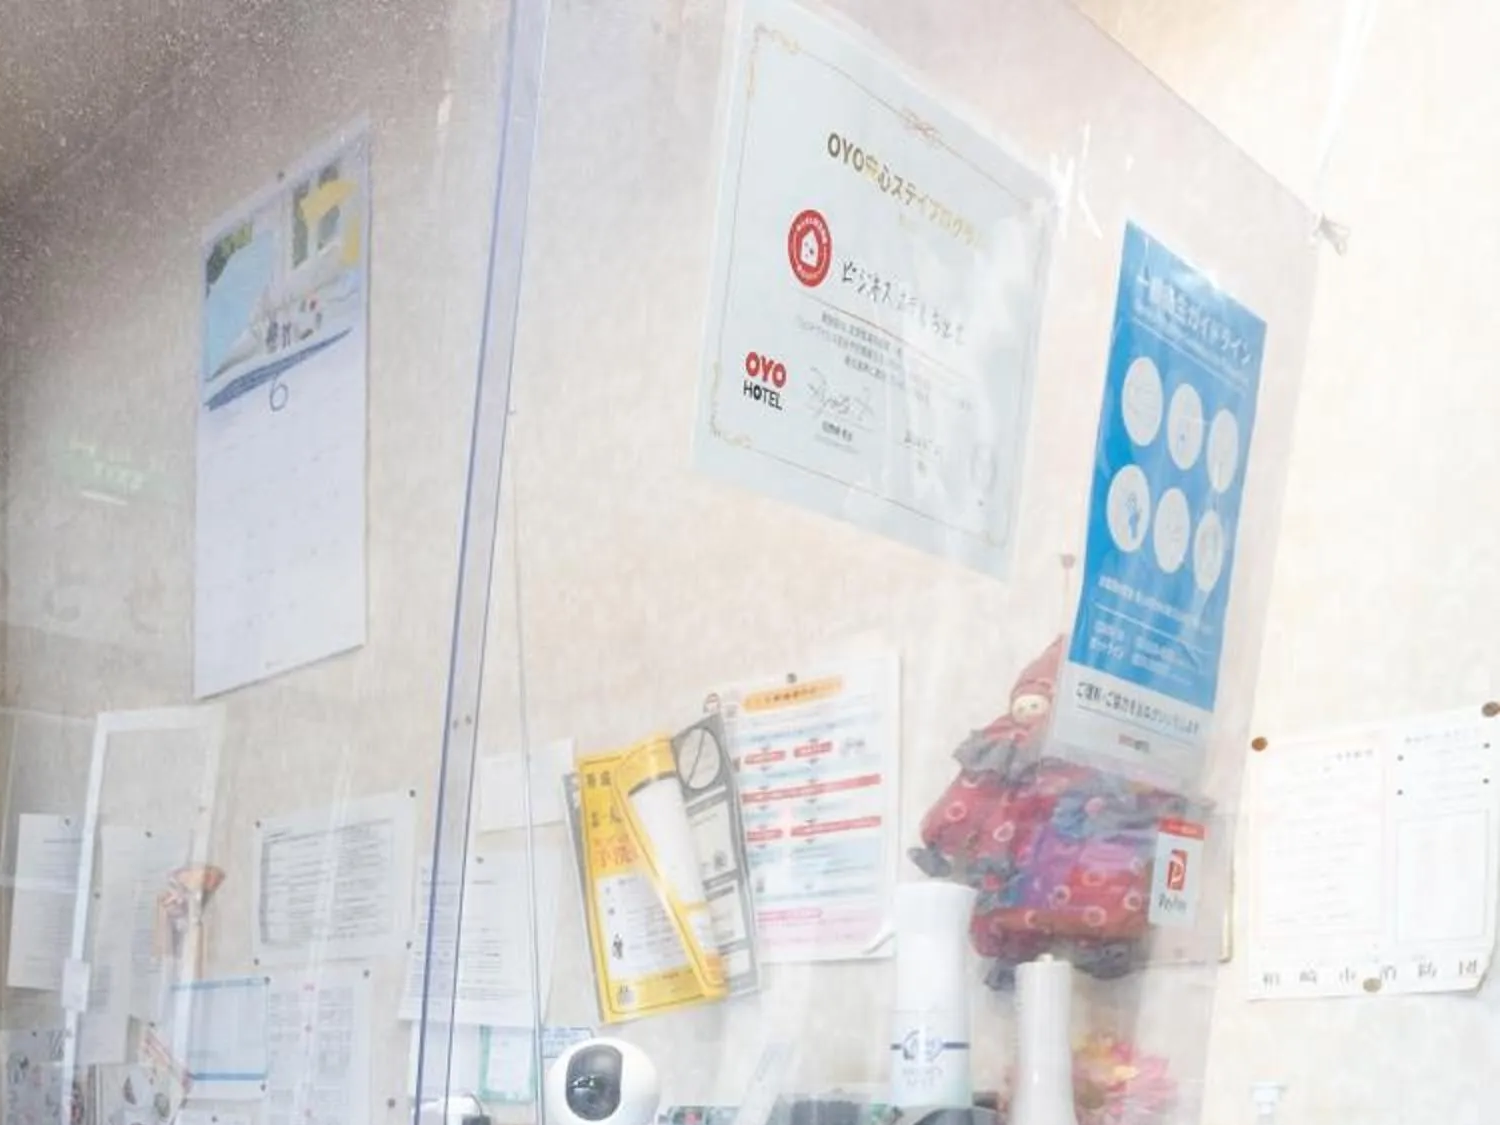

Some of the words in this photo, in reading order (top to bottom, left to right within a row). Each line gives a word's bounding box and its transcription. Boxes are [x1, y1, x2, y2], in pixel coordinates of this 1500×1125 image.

[745, 351, 787, 389] OYO
[269, 375, 289, 412] 6
[743, 380, 783, 411] HOTEL
